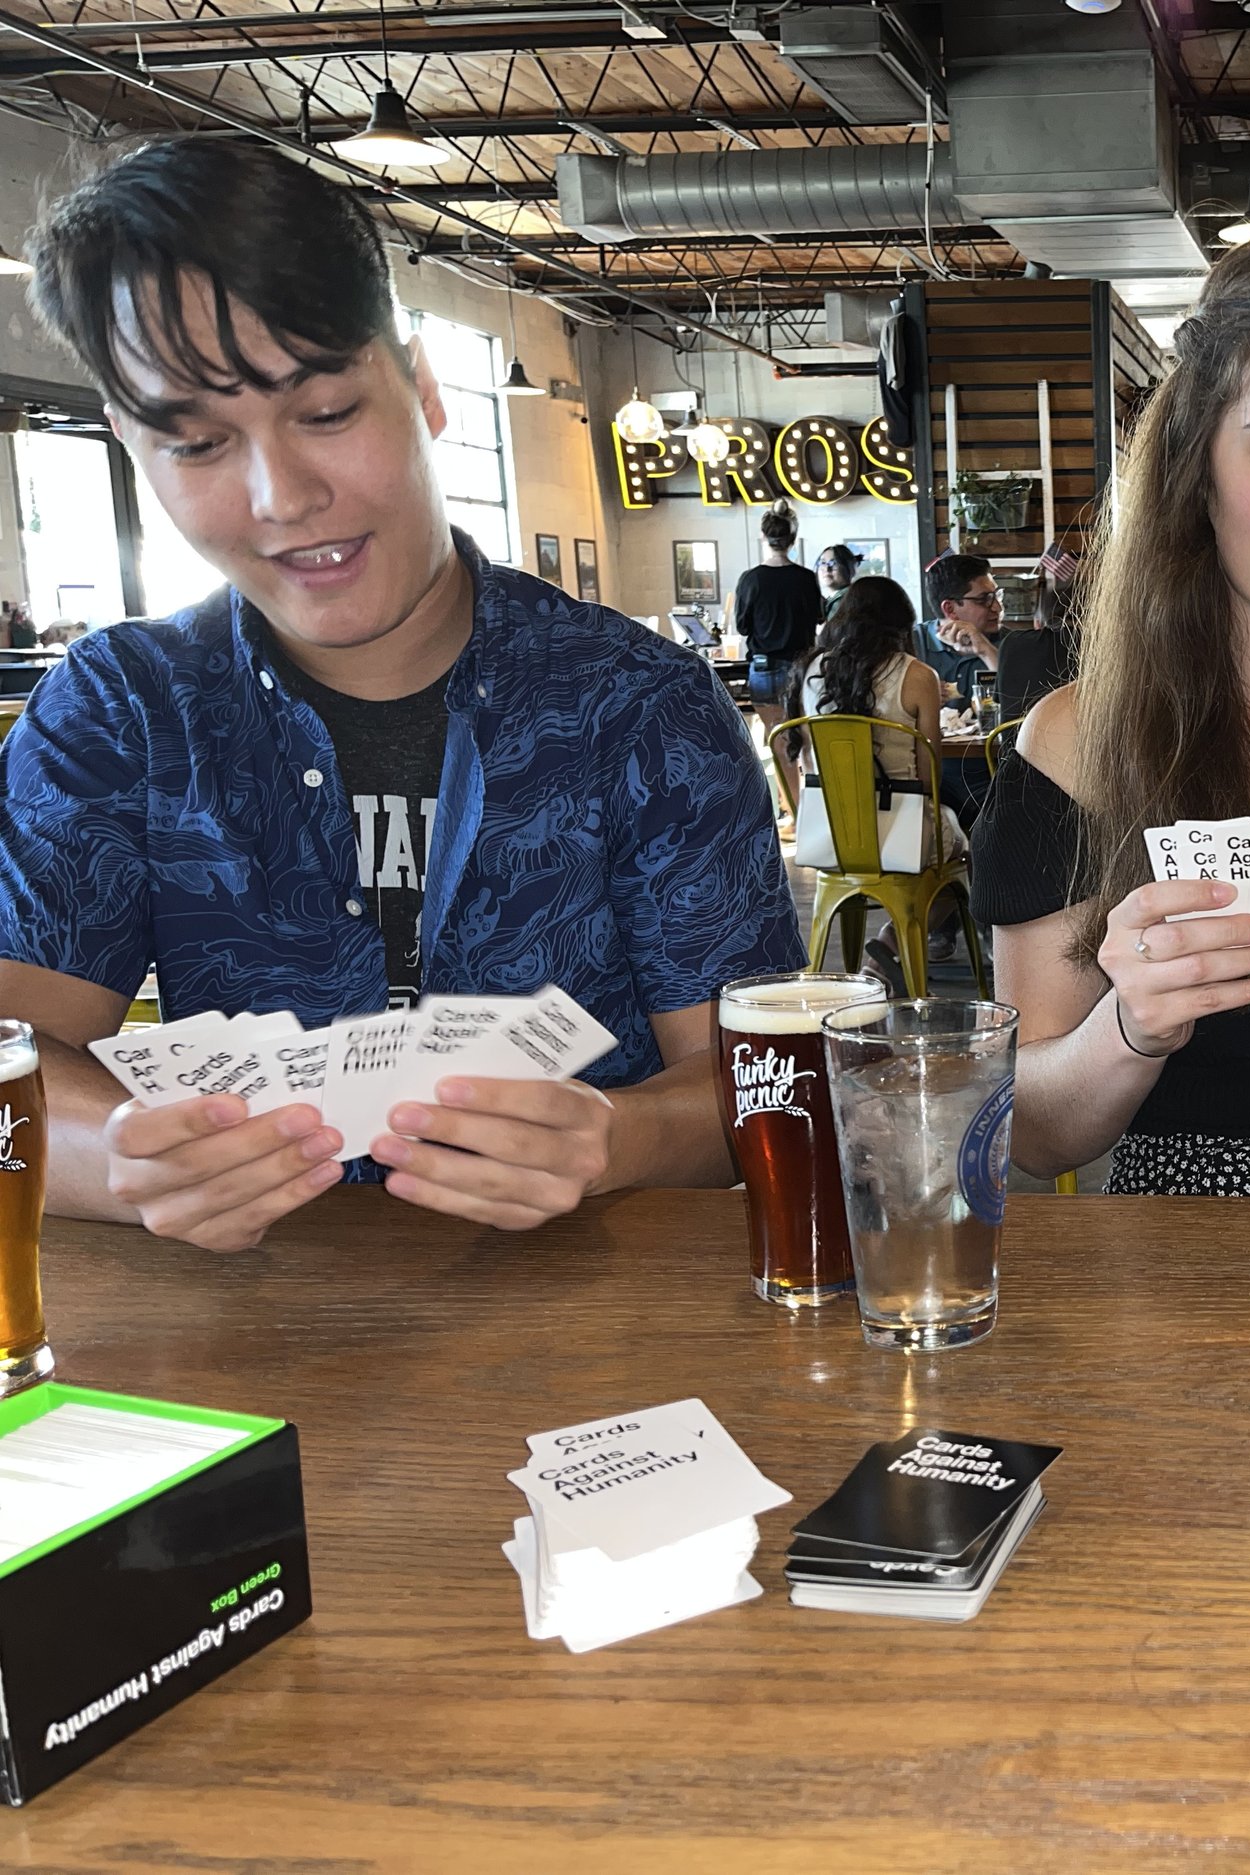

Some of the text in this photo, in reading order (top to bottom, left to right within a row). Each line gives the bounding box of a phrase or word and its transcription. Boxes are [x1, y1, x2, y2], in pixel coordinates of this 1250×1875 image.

[611, 415, 918, 509] PROS
[176, 1050, 233, 1088] Cards
[198, 1053, 262, 1096] Agains
[554, 1421, 642, 1448] Cards
[917, 1436, 994, 1459] Cards
[538, 1449, 626, 1481] Cards
[554, 1449, 662, 1492] Against
[561, 1450, 699, 1501] Humanity
[887, 1459, 1017, 1491] Humanity
[900, 1448, 1003, 1474] Against
[210, 1562, 282, 1613] Green Box
[44, 1587, 285, 1750] Cards Against Humanity
